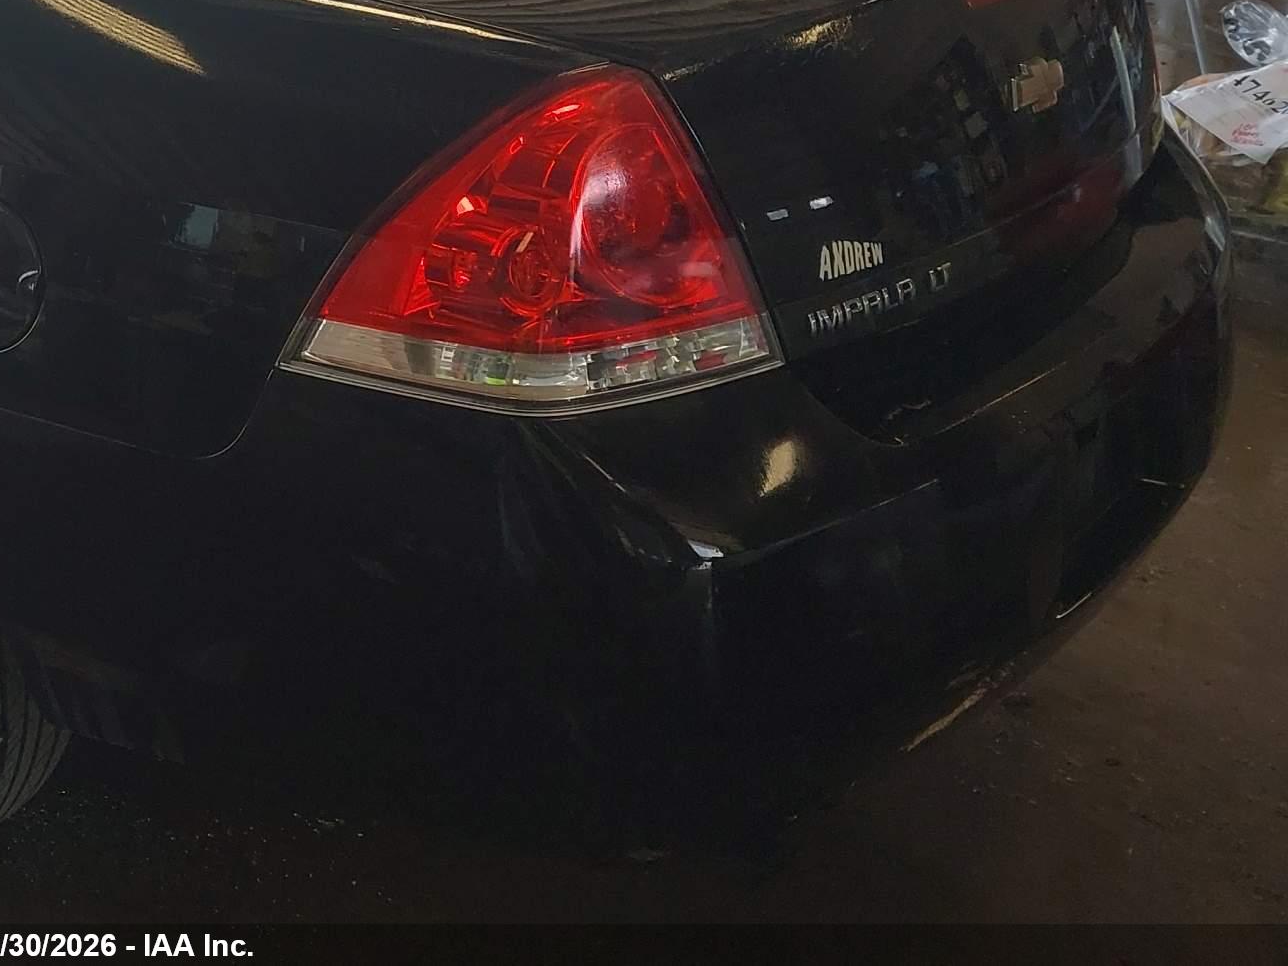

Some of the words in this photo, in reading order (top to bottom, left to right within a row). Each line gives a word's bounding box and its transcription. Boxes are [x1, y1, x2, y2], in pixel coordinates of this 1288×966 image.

[819, 240, 884, 282] ANDREW
[807, 277, 917, 334] IMPALA
[928, 261, 952, 291] LT
